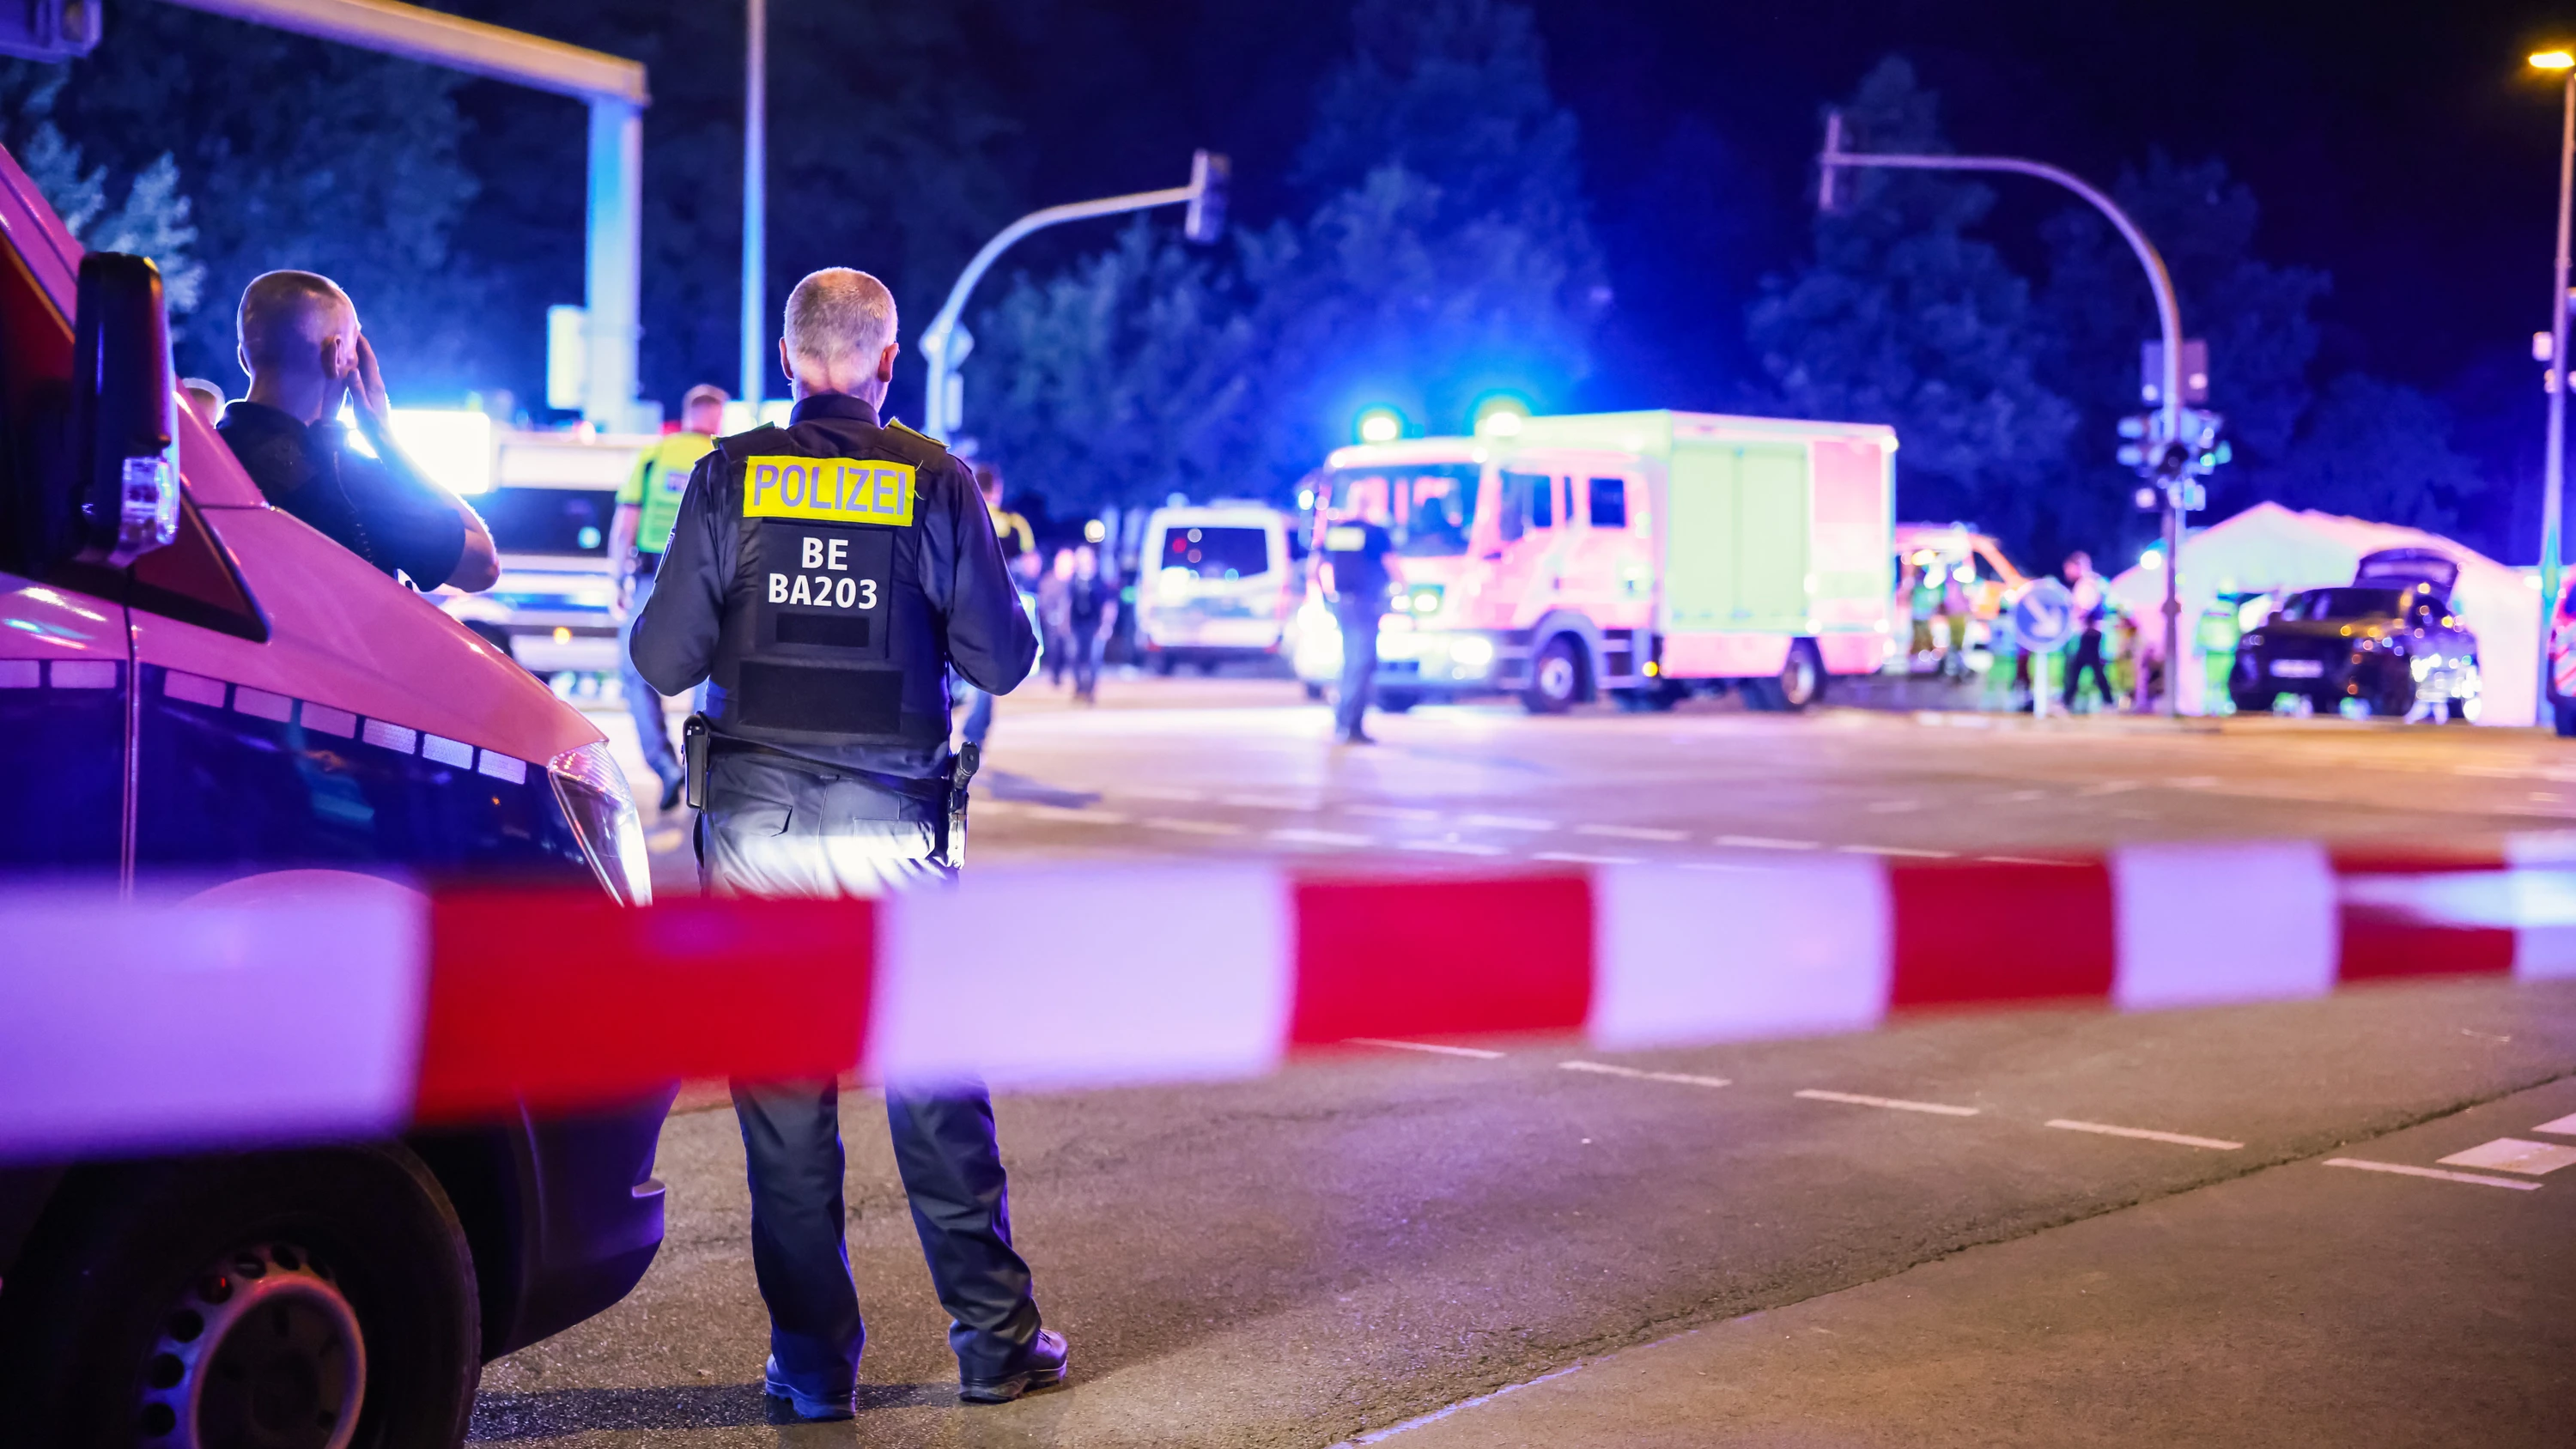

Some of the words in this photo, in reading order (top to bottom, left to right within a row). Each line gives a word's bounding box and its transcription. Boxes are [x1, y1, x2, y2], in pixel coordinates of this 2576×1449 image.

[753, 464, 906, 516] POLIZEI
[801, 537, 849, 571] BE
[769, 573, 878, 609] BA203
